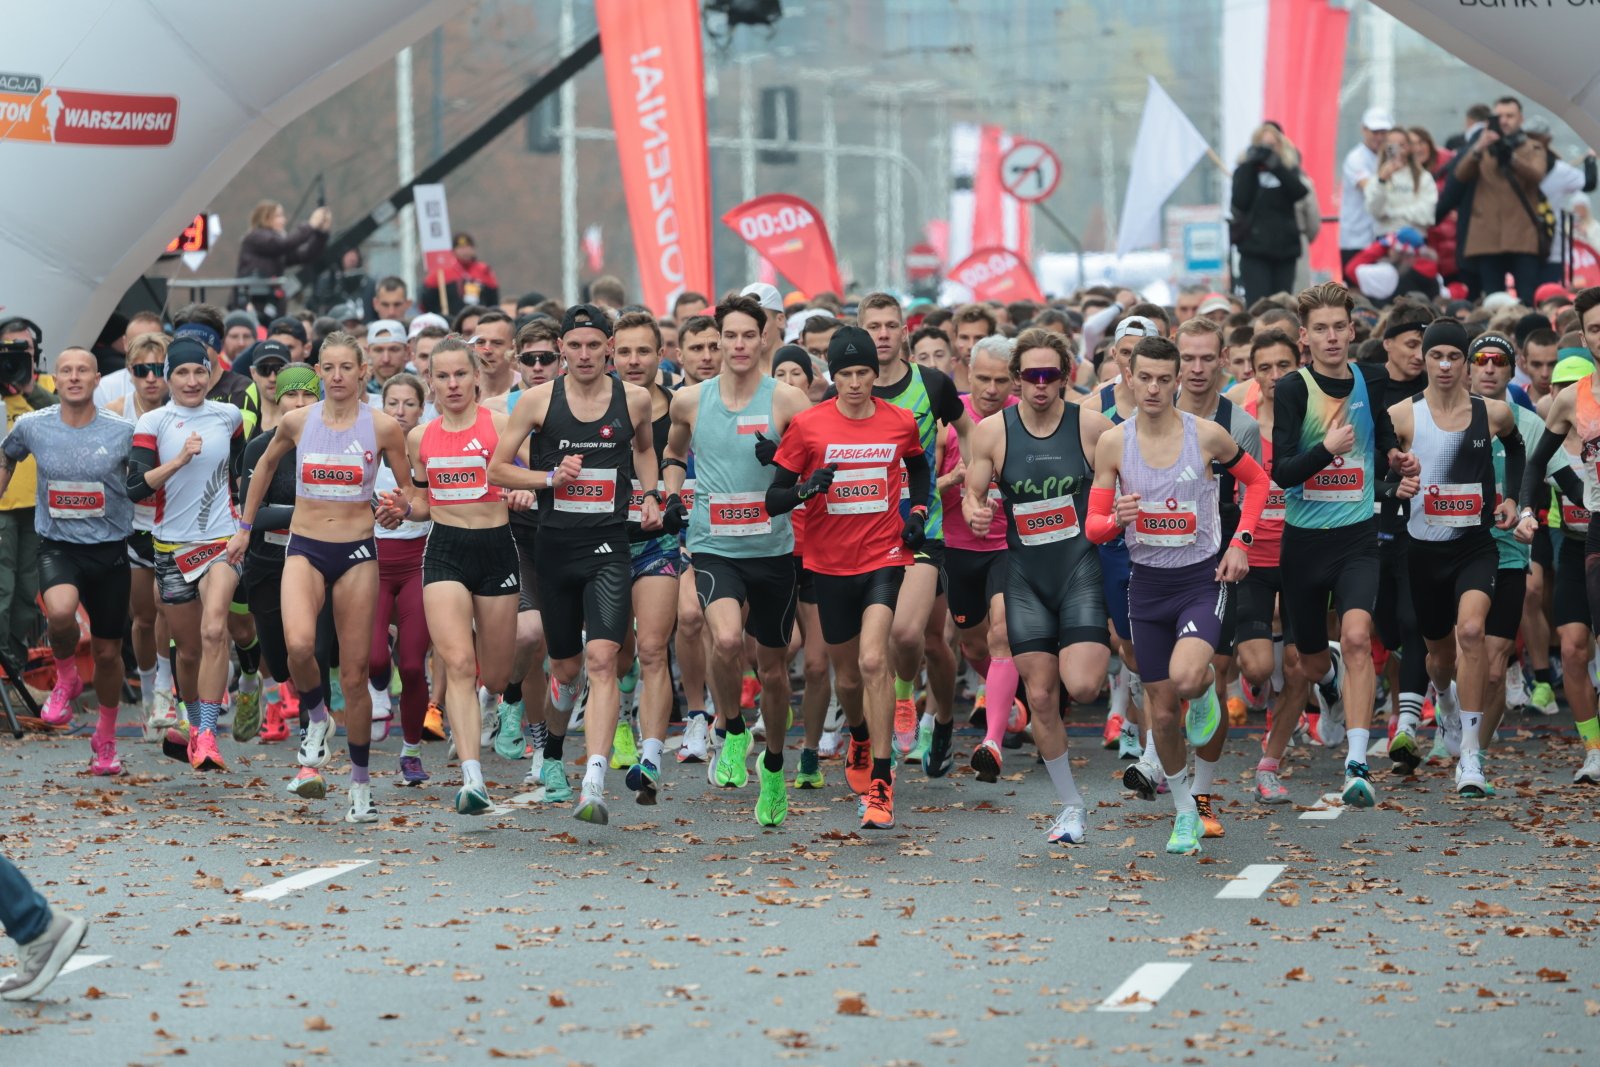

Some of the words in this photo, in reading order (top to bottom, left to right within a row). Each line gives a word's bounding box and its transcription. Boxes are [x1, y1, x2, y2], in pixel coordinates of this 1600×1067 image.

[0, 101, 32, 123] TON
[64, 107, 173, 131] WARSZAWSKI
[828, 448, 893, 460] ZABIEGANI
[311, 469, 354, 481] 18403
[436, 471, 477, 484] 18401
[1314, 473, 1357, 486] 18404
[566, 485, 604, 497] 9925
[835, 484, 879, 498] 18402
[56, 495, 97, 506] 25270
[1433, 499, 1475, 512] 18405
[719, 507, 760, 520] 13353
[1027, 513, 1065, 530] 9968
[1143, 518, 1187, 530] 18400
